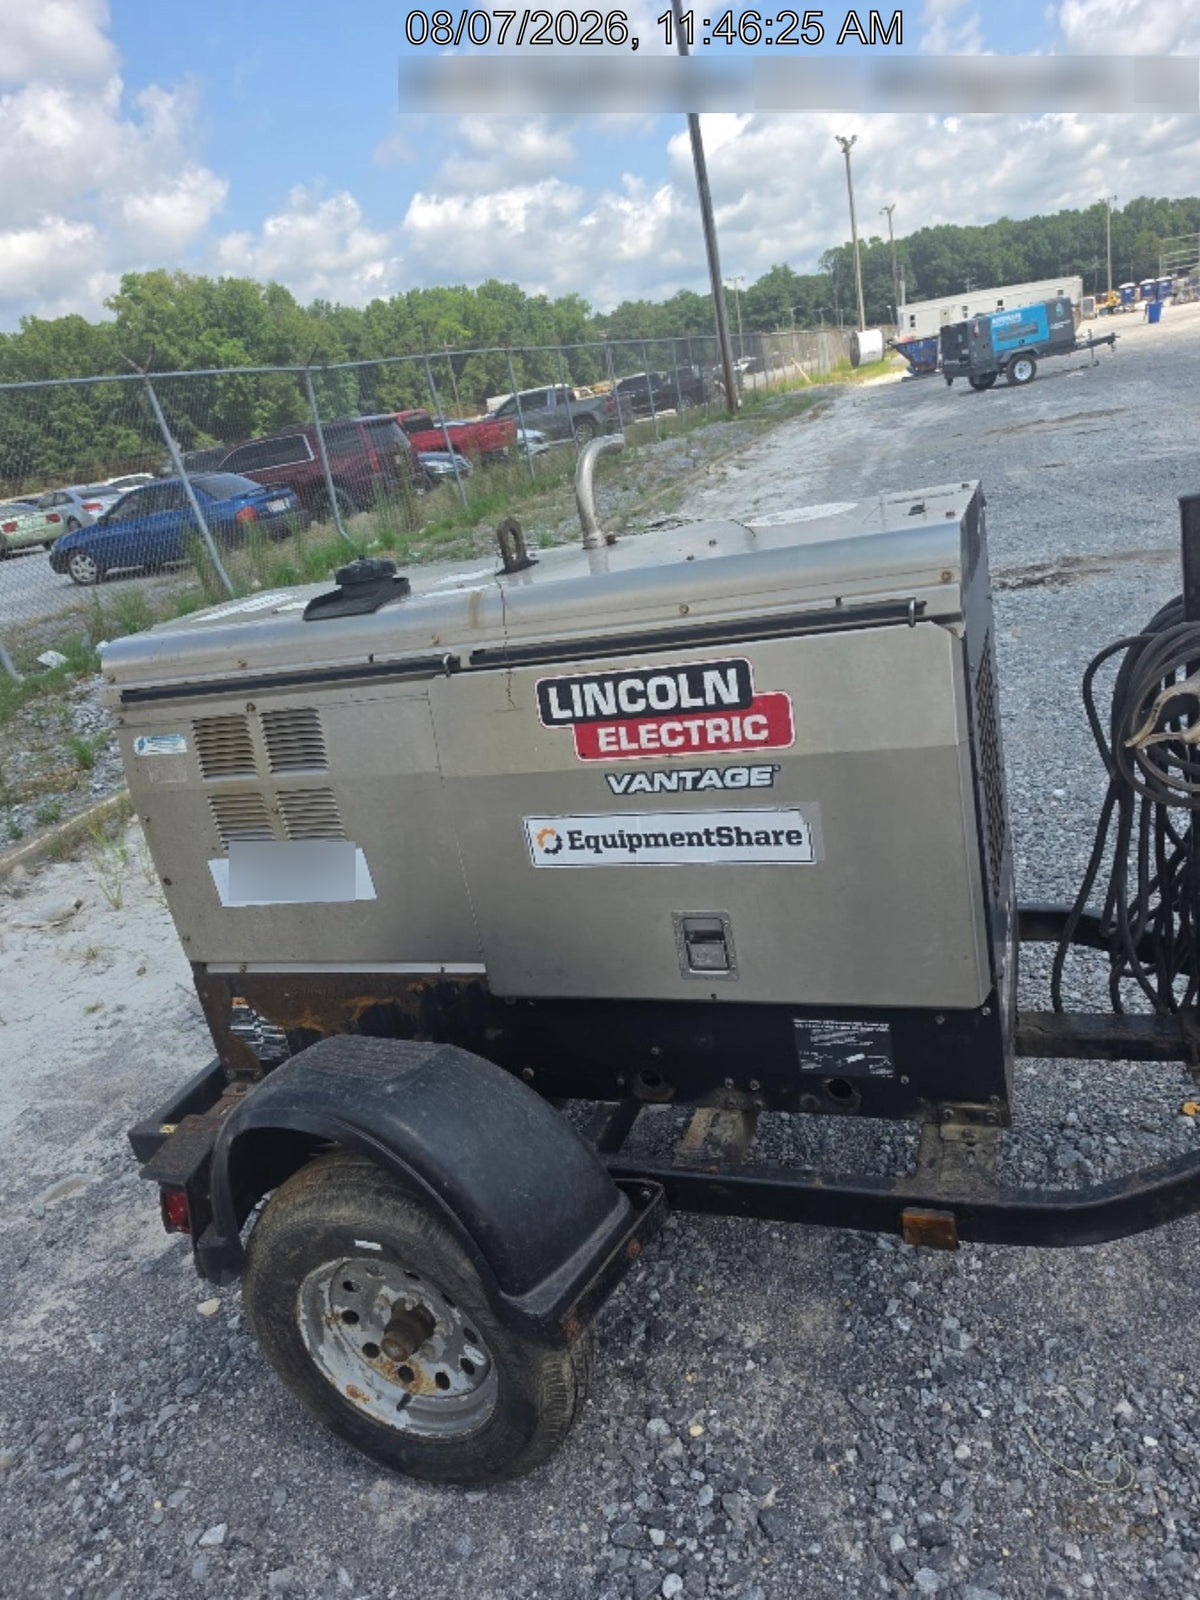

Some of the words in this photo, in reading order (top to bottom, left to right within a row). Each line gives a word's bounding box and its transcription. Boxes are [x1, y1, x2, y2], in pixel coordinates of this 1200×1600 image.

[546, 667, 741, 720] LINCOLN
[597, 713, 769, 753] ELECTRIC
[605, 764, 774, 795] VANTAGE
[566, 825, 803, 855] EquipmentShare
